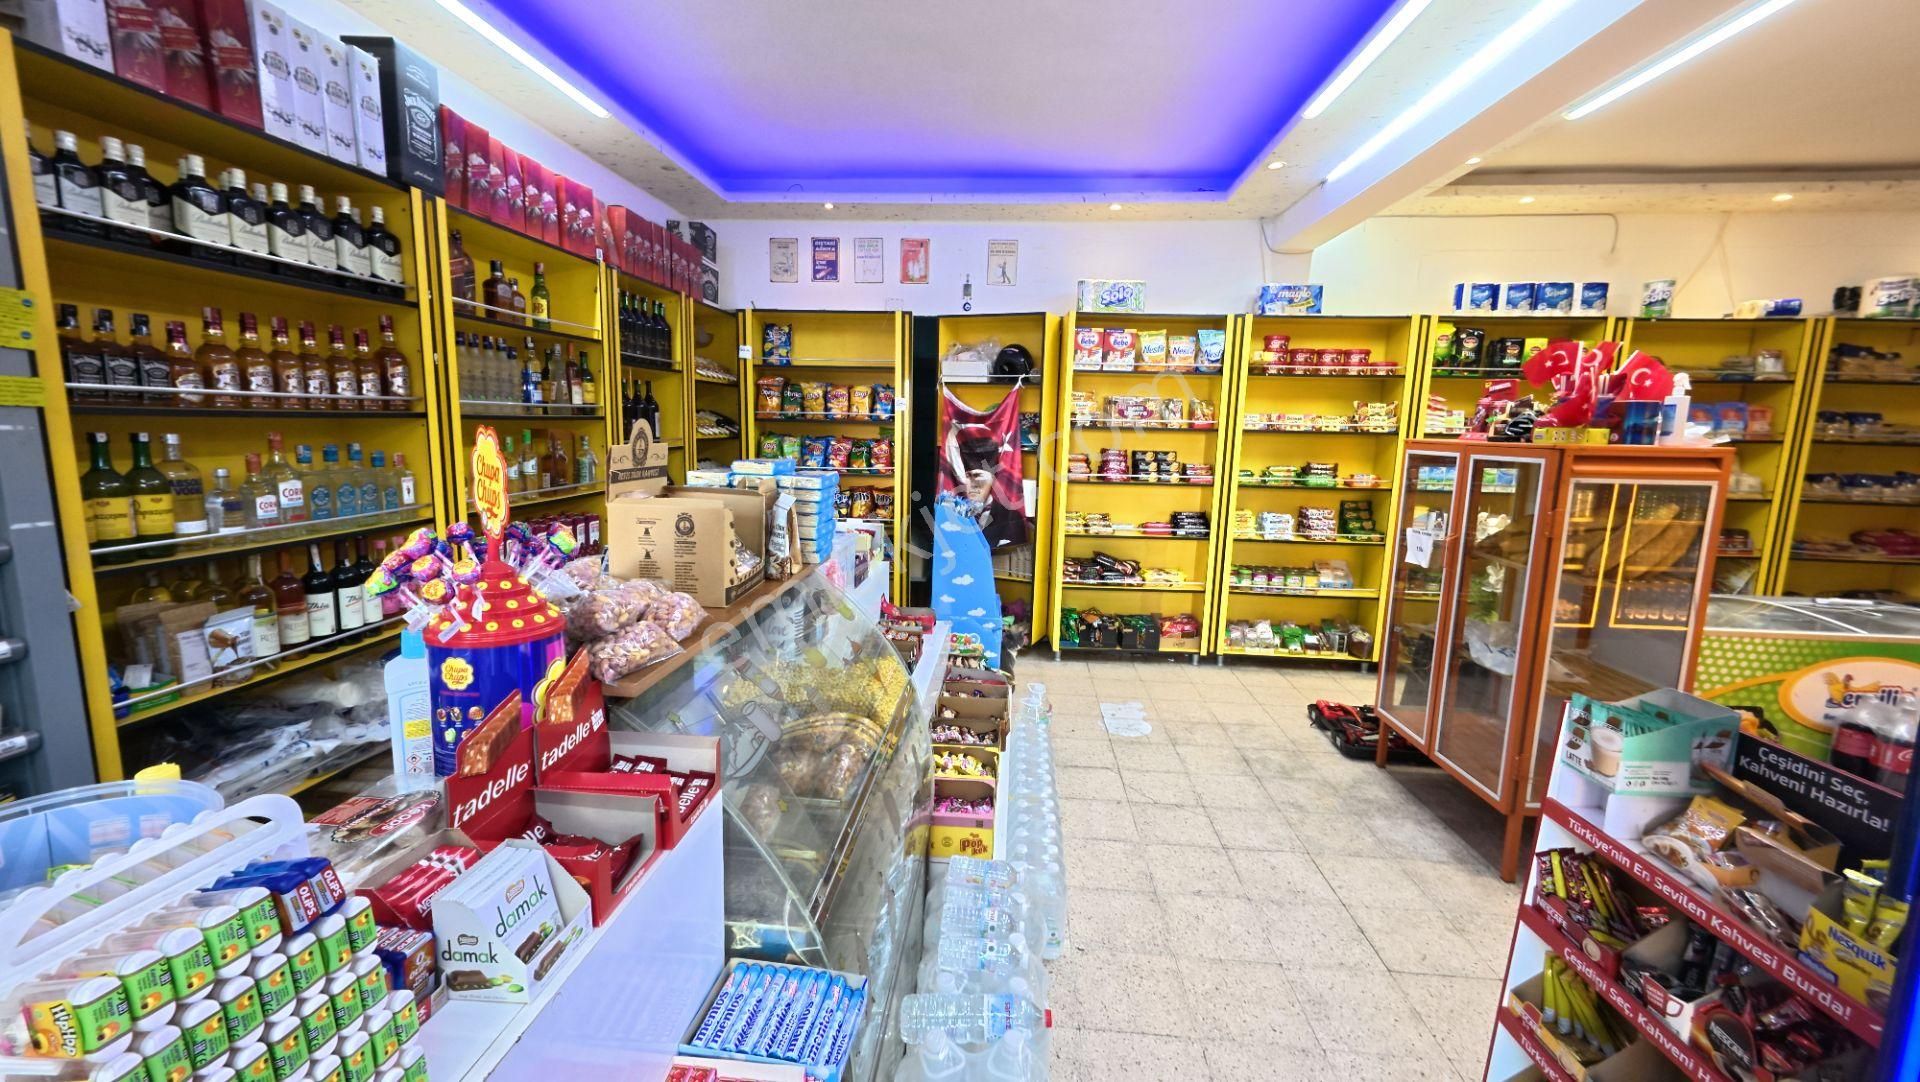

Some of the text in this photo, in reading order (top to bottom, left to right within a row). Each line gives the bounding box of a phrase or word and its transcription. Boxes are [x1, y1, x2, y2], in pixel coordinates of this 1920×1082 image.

[1101, 286, 1133, 306] Solo
[1642, 289, 1673, 305] Solo
[477, 454, 500, 484] Chupa
[477, 479, 501, 509] Chups
[445, 663, 469, 675] Chupa
[445, 672, 468, 683] Chups
[542, 722, 590, 771] tadelle
[1565, 750, 1582, 767] LATTE
[453, 764, 528, 828] tadelle
[1739, 755, 1890, 833] Kahveni Hazırla!
[1758, 746, 1870, 806] Çeşidini Seç,
[495, 875, 548, 938] damak
[1567, 815, 1632, 870] Türkiye'nin
[1633, 862, 1651, 881] En
[1654, 876, 1708, 922] Sevilen
[1710, 915, 1779, 970] Kahvesi
[1782, 963, 1852, 1020] Burda!
[442, 940, 499, 964] damak
[1828, 926, 1888, 971] Nesquik
[695, 991, 730, 1043] mentos
[711, 992, 745, 1045] mentos
[1563, 947, 1608, 992] Çeşidini
[1609, 986, 1635, 1019] Seç,
[1637, 1011, 1695, 1069] Kahveni
[1519, 1034, 1563, 1082] Türkiye'
